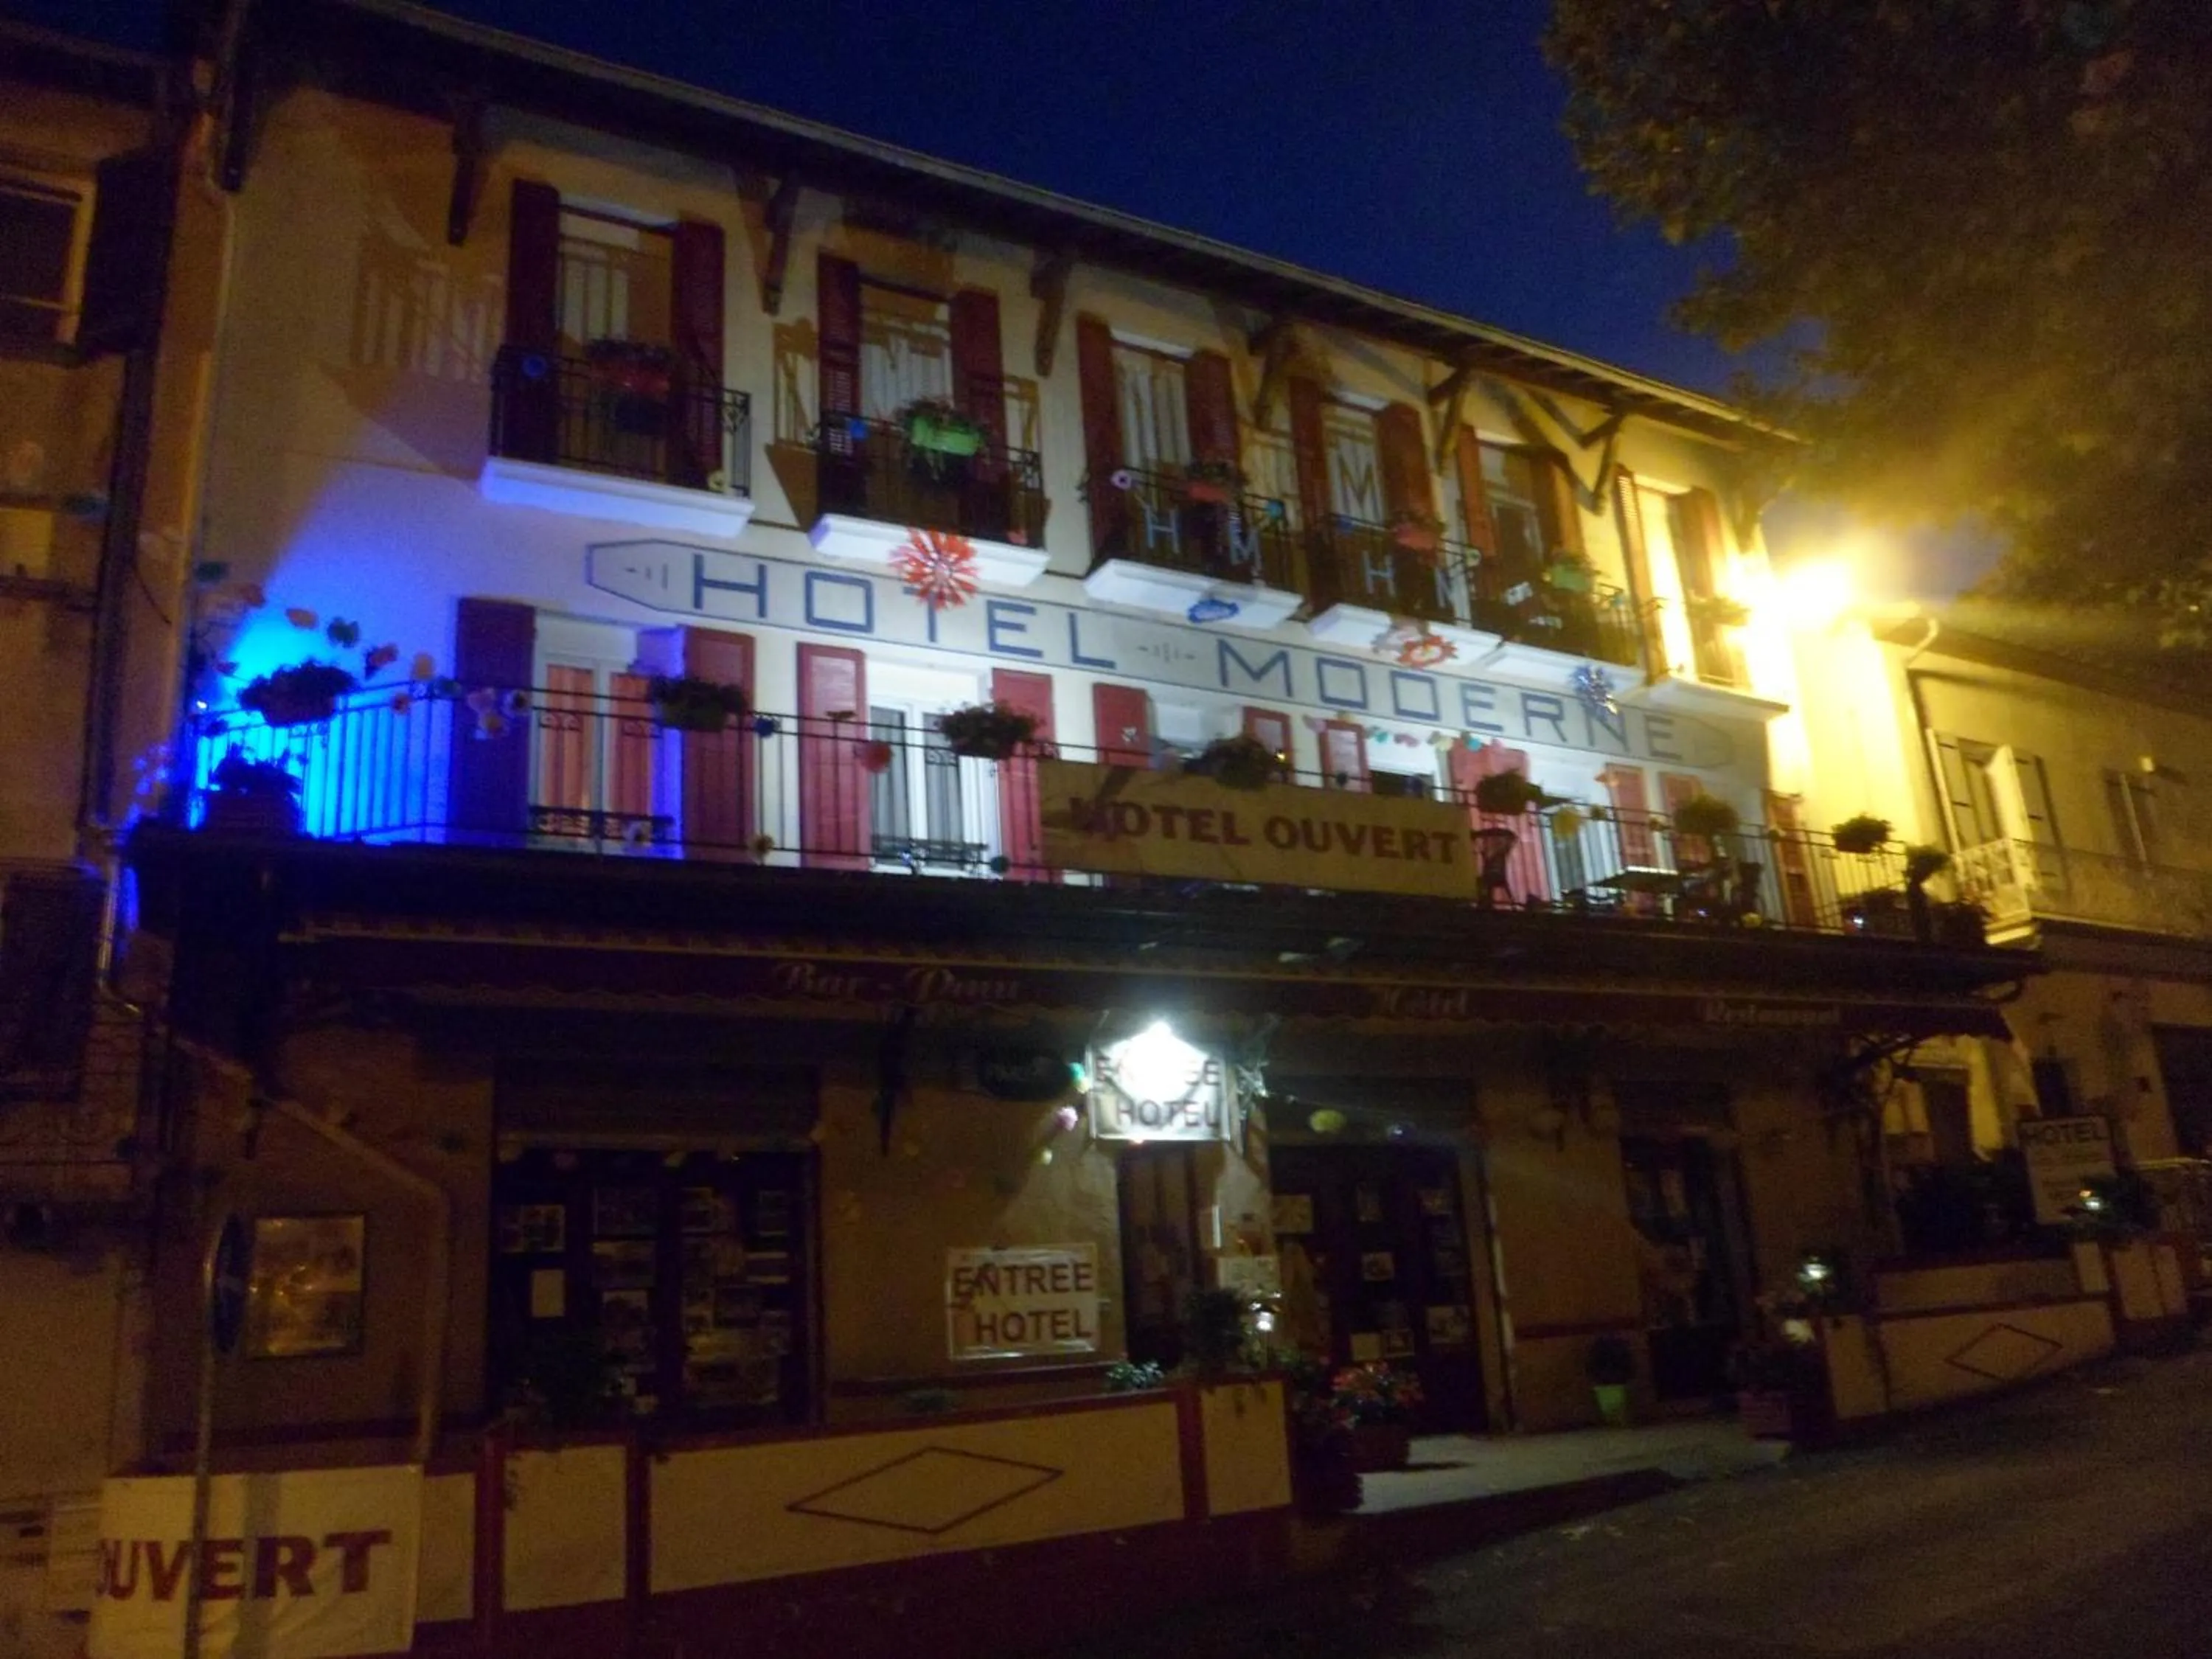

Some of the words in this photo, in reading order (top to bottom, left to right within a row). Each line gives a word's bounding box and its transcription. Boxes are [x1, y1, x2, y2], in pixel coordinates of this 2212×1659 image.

[693, 553, 1116, 670] HOTEL
[1216, 638, 1683, 760] MODERNE
[1069, 796, 1251, 847] HOTEL
[1263, 815, 1459, 864] OUVERT
[1117, 1099, 1221, 1129] HOTEL
[953, 1262, 1094, 1298] ENTREE
[975, 1309, 1092, 1343] HOTEL
[97, 1529, 393, 1601] UVERT
